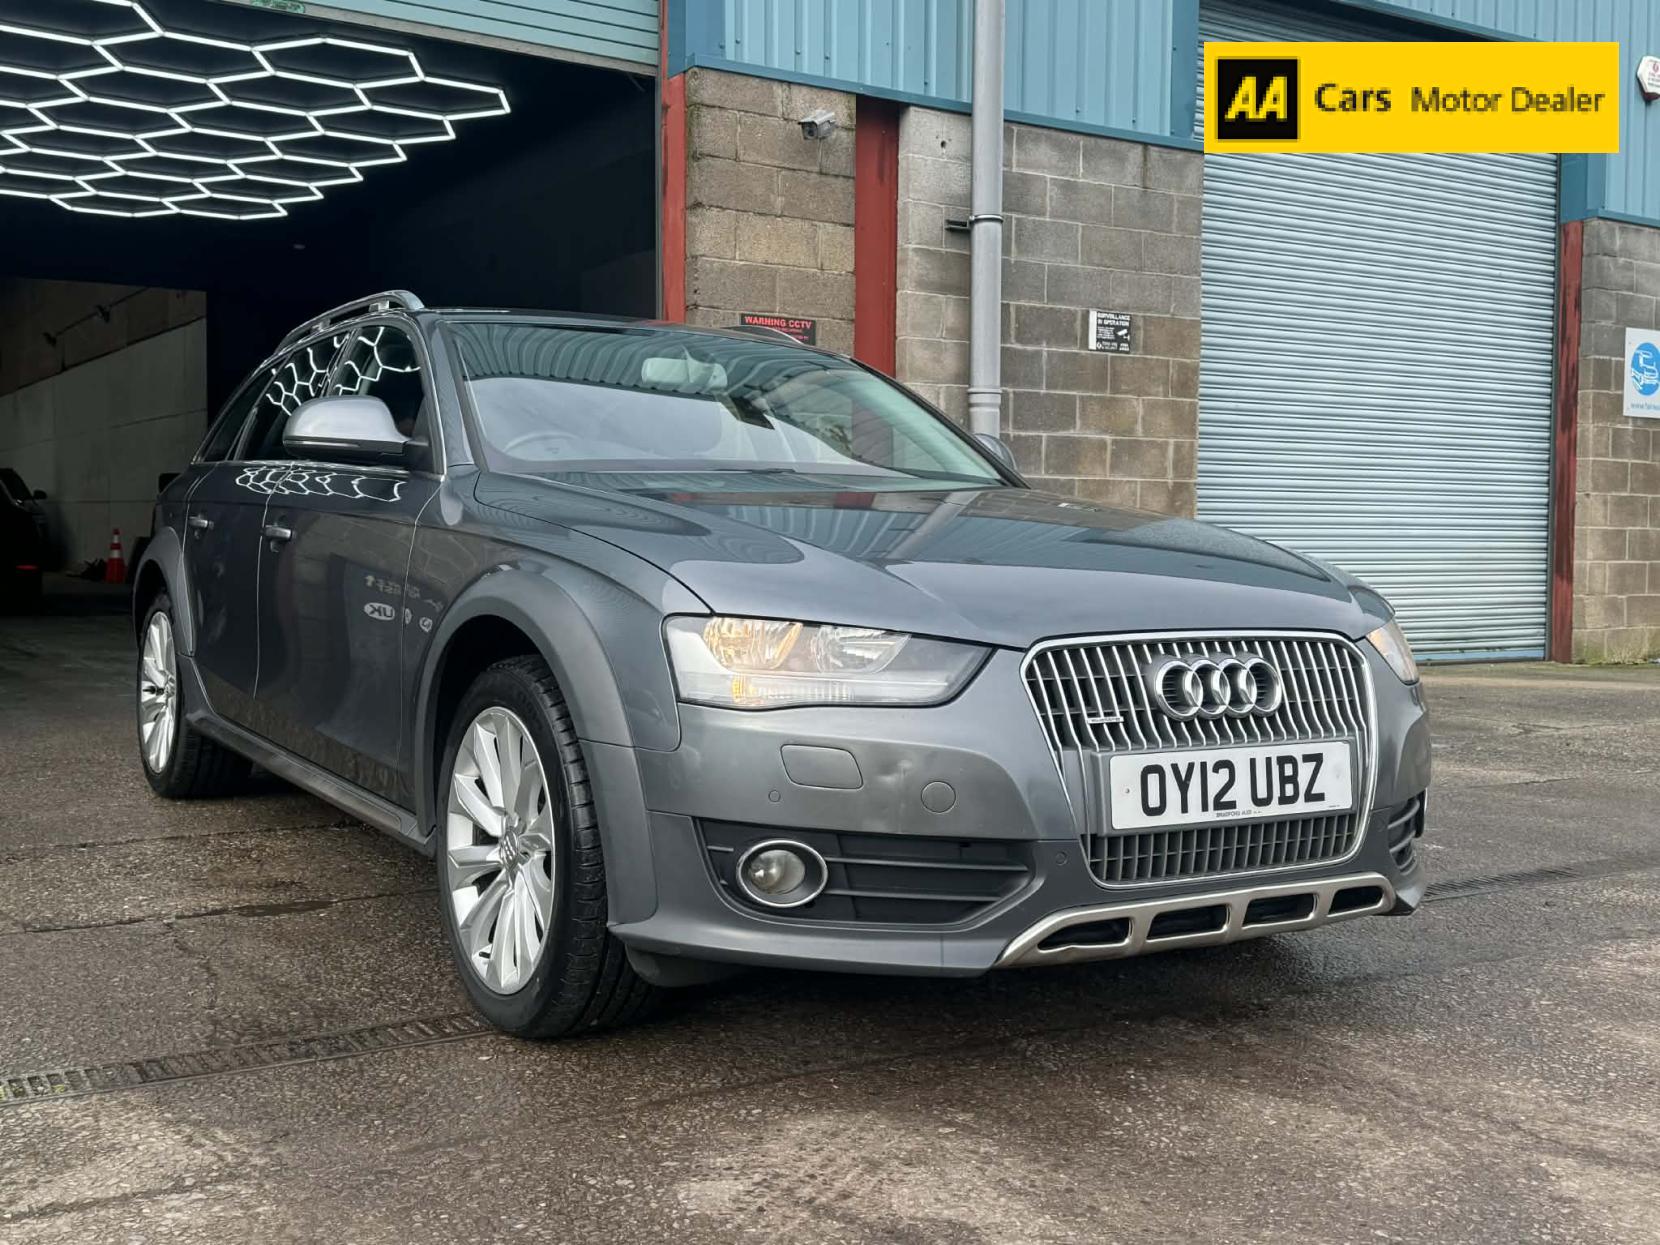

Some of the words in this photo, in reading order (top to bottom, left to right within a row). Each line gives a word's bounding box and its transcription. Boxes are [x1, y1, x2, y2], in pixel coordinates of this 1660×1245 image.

[744, 315, 787, 328] WARNING
[788, 319, 812, 329] CCTV
[1140, 759, 1237, 817] OY12
[1249, 752, 1326, 808] UBZ
